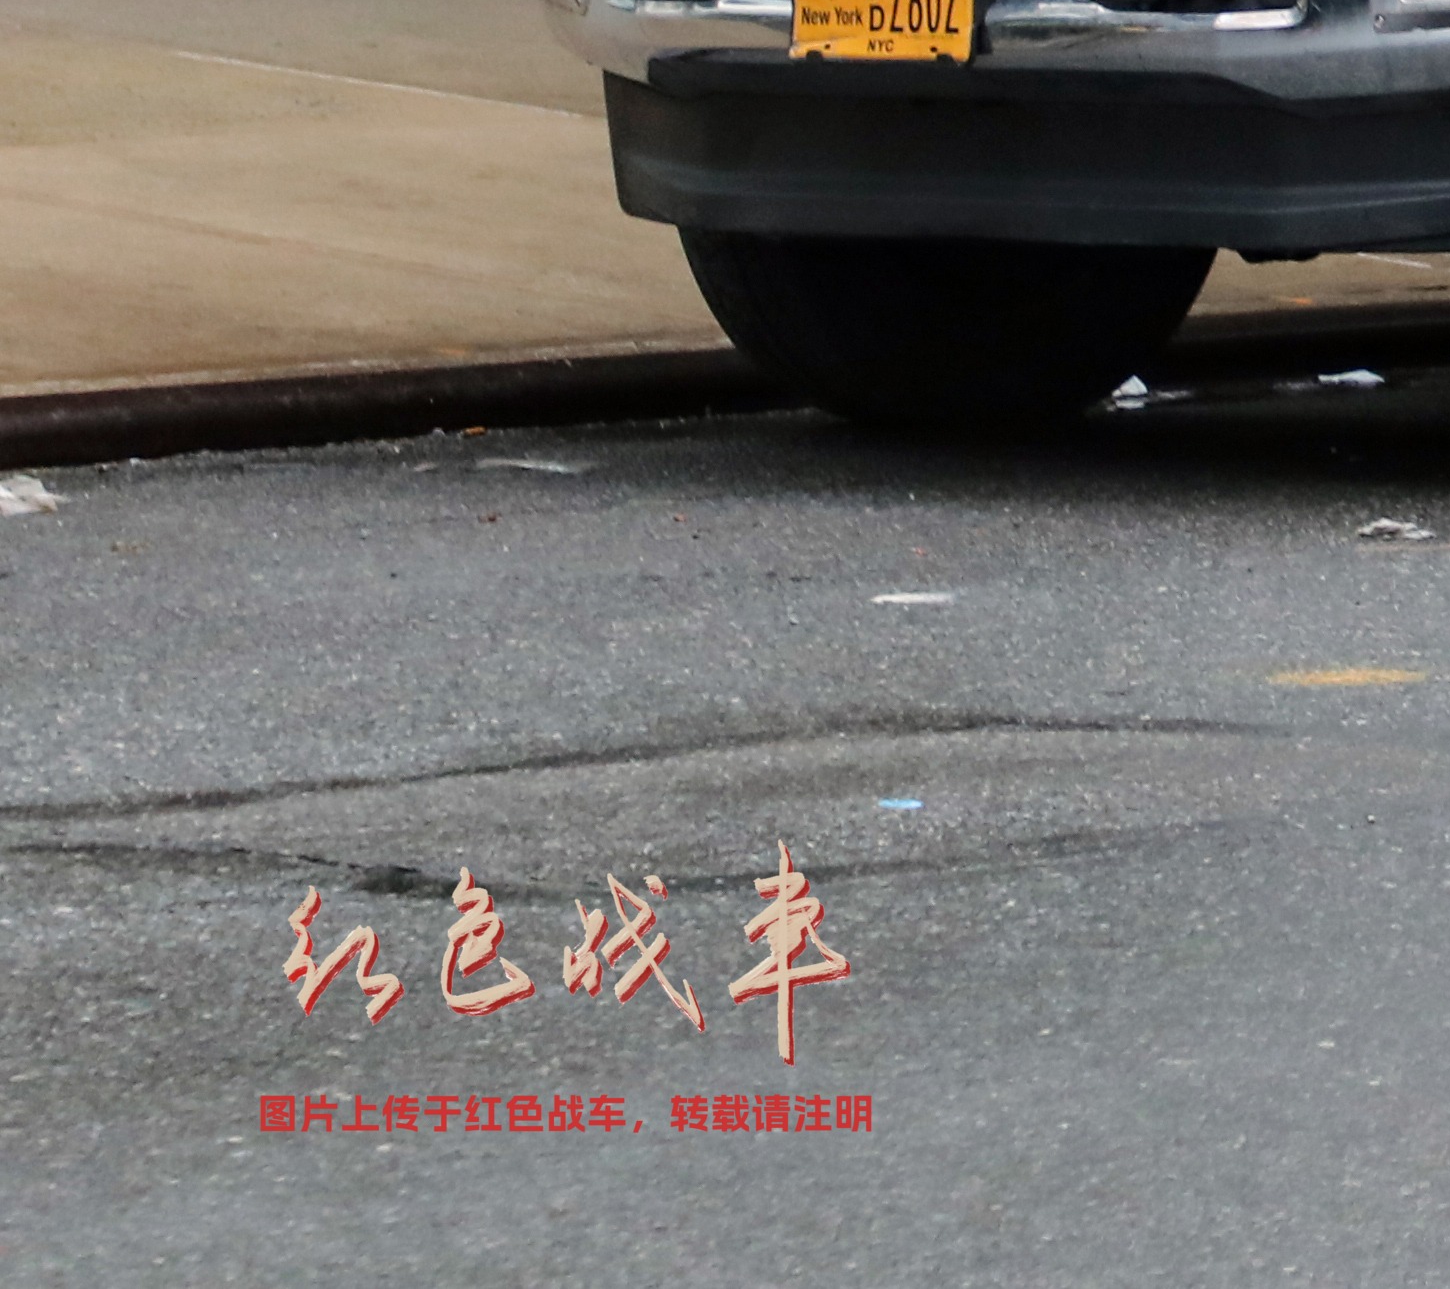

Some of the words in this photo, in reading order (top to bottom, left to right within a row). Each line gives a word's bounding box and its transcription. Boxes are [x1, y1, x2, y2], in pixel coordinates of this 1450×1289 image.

[801, 5, 831, 26] New
[834, 6, 864, 28] York
[867, 38, 895, 53] NYC
